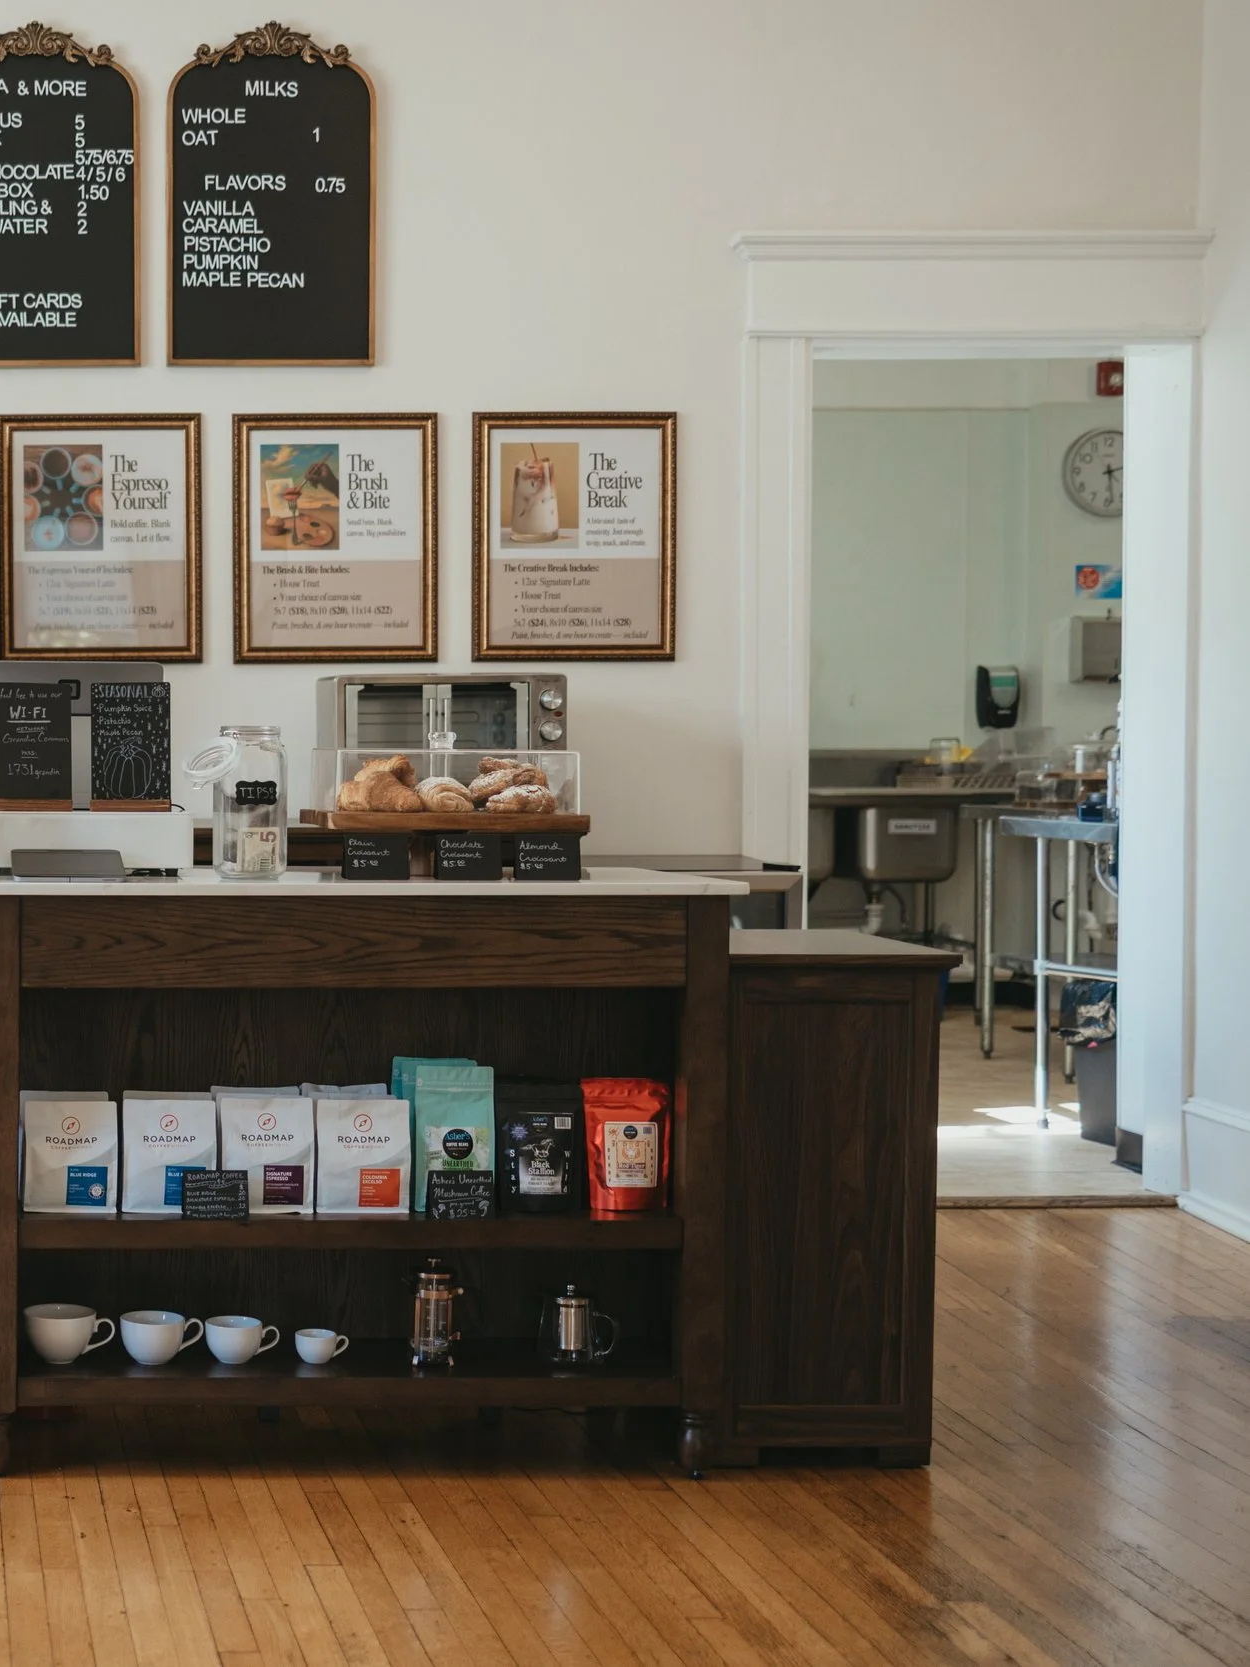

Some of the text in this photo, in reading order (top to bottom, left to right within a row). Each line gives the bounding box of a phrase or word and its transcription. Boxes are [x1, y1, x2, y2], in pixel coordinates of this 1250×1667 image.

[17, 81, 29, 95] &
[35, 81, 86, 96] MORE
[245, 81, 298, 97] MILKS
[75, 115, 85, 130] 5
[182, 108, 246, 124] WHOLE
[75, 133, 85, 148] 5
[182, 127, 320, 145] OAT 1
[205, 175, 345, 193] FLAVORS 0.75
[79, 185, 109, 200] 1.50
[41, 200, 52, 214] &
[77, 202, 87, 216] 2
[183, 201, 254, 216] VANILLA
[77, 219, 87, 234] 2
[182, 219, 263, 234] CARAMEL
[184, 237, 270, 252] PISTACHIO
[184, 255, 258, 269] PUMPKIN
[183, 272, 304, 288] MAPLE PECAN
[24, 293, 82, 308] CARDS
[110, 455, 137, 472] The
[347, 454, 374, 472] The
[589, 453, 616, 470] The
[111, 474, 168, 493] Espresso
[348, 473, 388, 490] Brush
[586, 471, 642, 489] Creative
[111, 492, 170, 509] Yourself
[347, 490, 390, 509] & Bite
[588, 490, 627, 508] Break
[99, 685, 152, 698] SEASONAL
[10, 705, 46, 719] WI-FI
[99, 704, 153, 714] Pumpkin Spice
[99, 716, 131, 724] Pistachio
[122, 728, 143, 736] Pecan
[239, 787, 274, 799] TIPS!
[46, 1137, 97, 1145] ROADMAP
